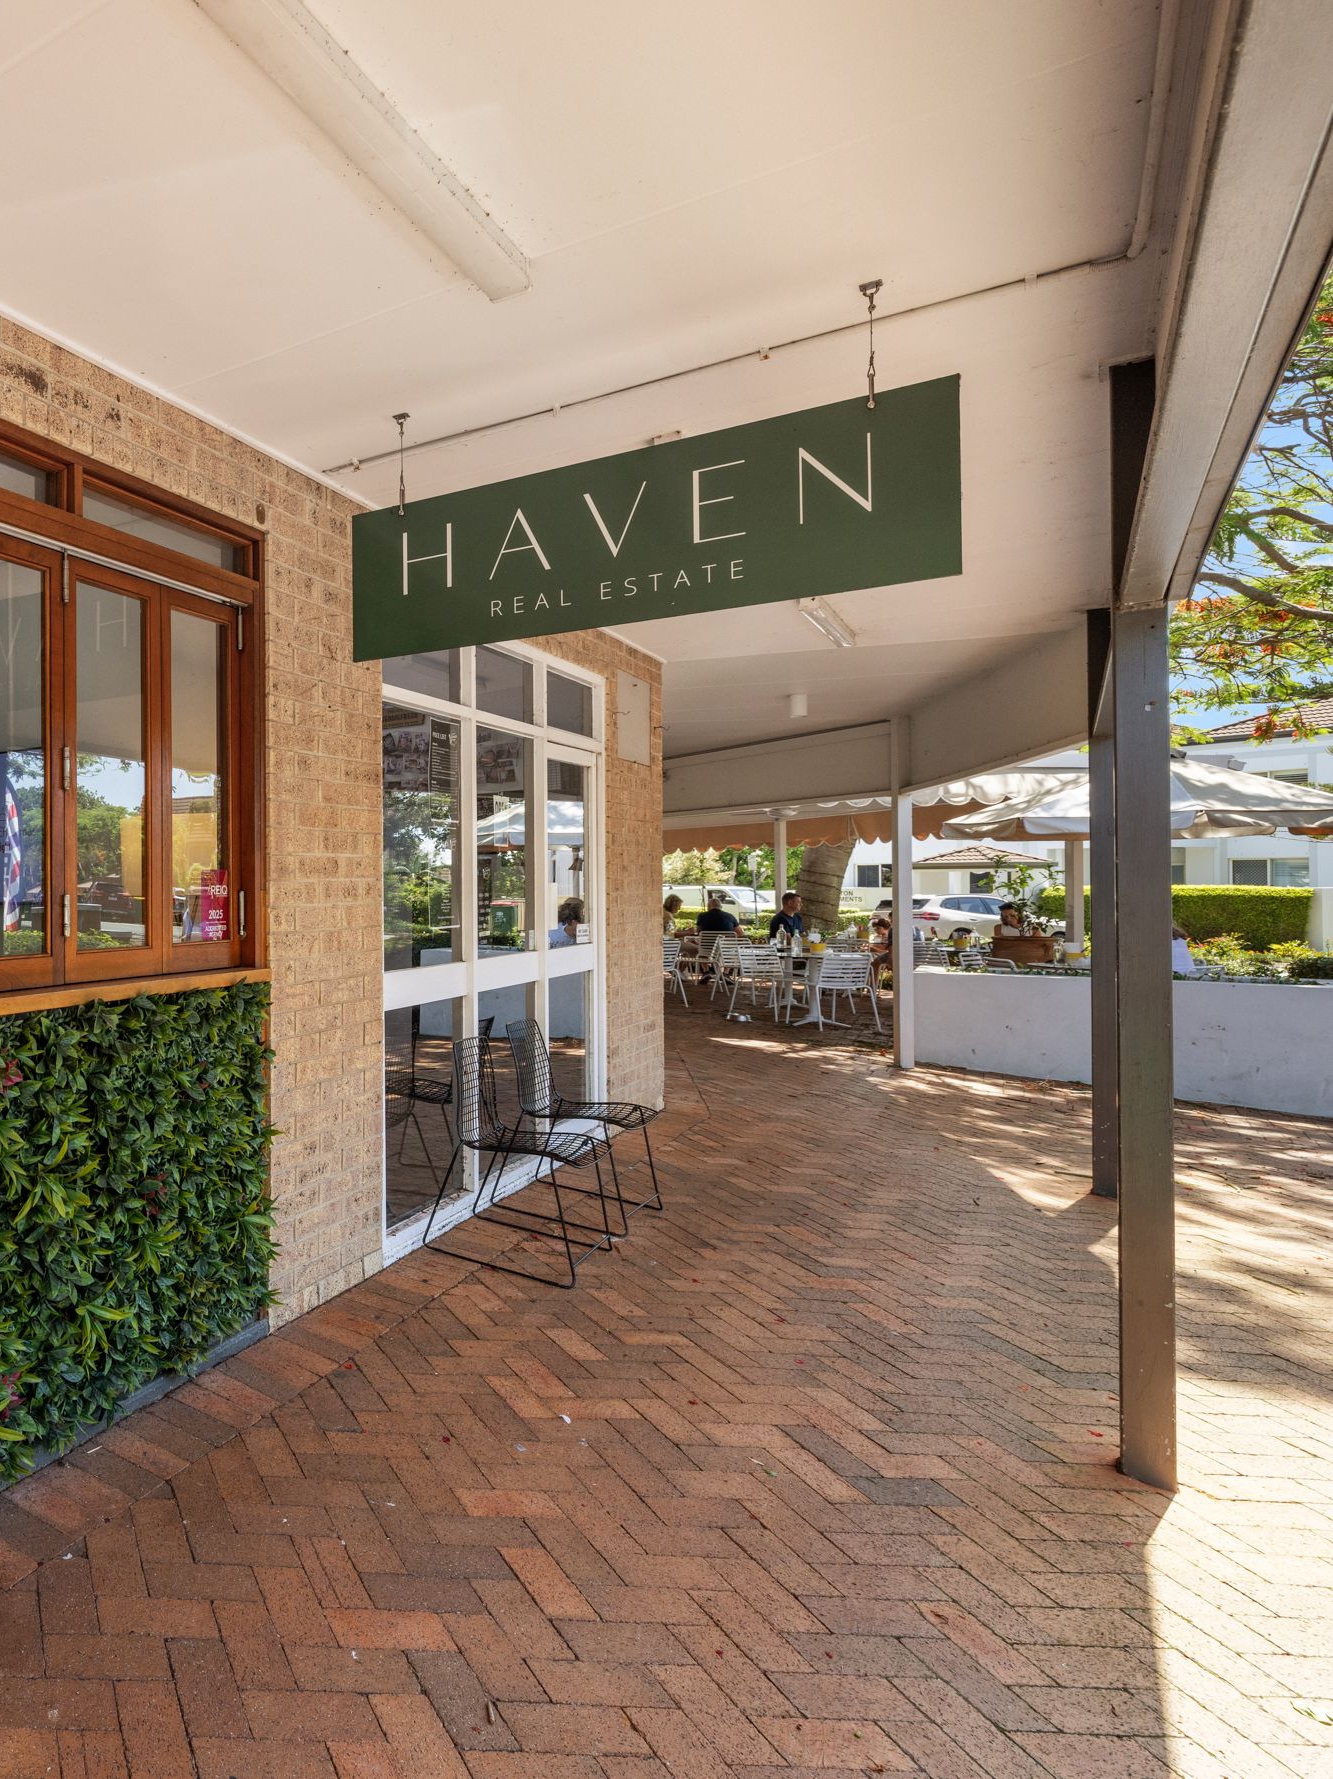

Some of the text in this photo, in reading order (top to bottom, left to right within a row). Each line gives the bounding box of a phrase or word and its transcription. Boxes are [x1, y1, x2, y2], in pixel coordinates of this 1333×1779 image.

[402, 432, 873, 595] HAVEN
[490, 559, 745, 617] REAL ESTATE
[208, 910, 224, 920] 2025
